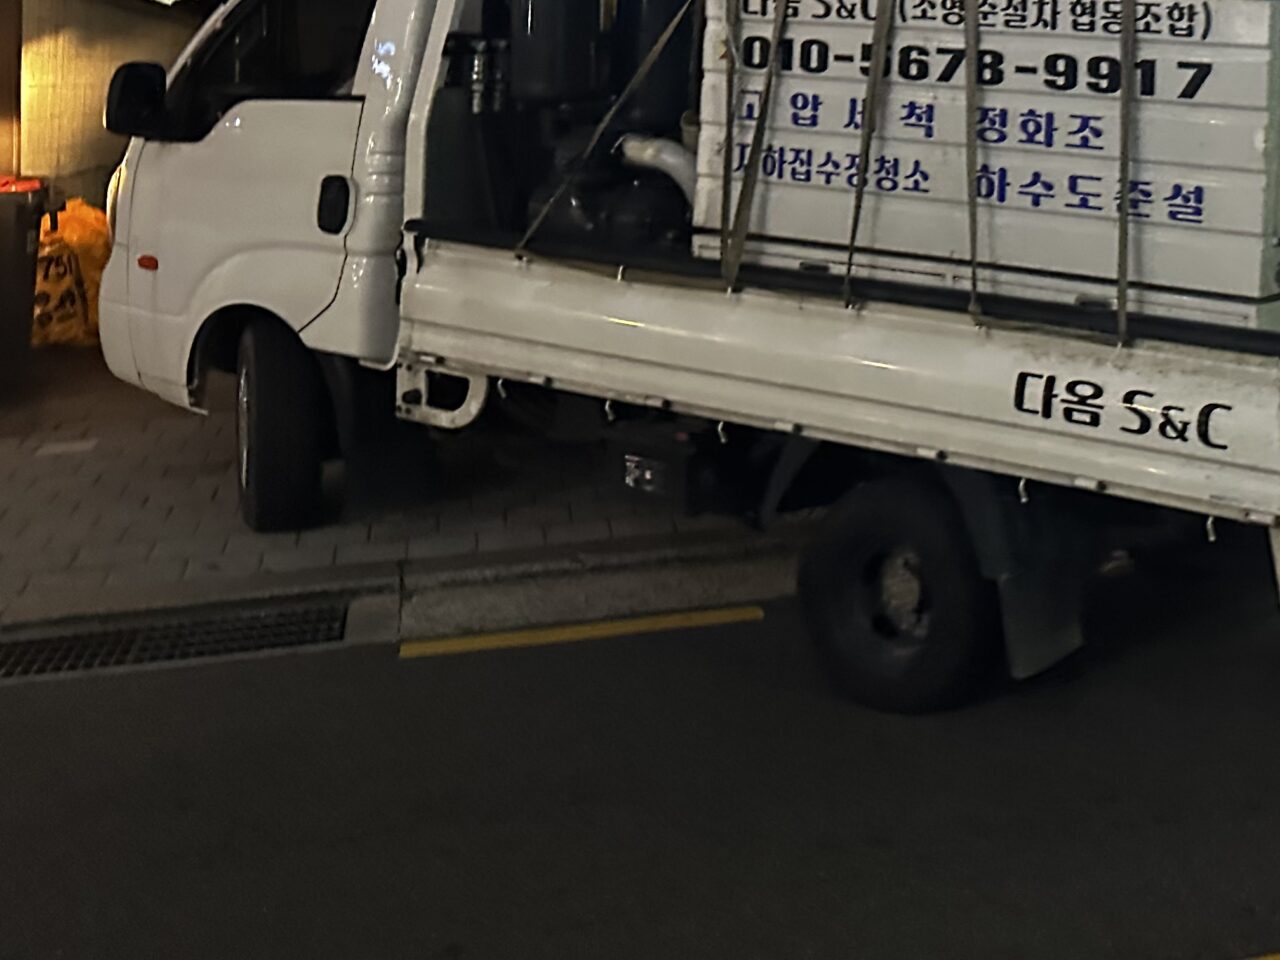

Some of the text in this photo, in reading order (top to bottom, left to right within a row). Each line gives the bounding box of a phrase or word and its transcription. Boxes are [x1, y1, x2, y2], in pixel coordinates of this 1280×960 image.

[742, 36, 1213, 100] 010-5678-9917
[1013, 371, 1233, 450] 다옴 S&C
